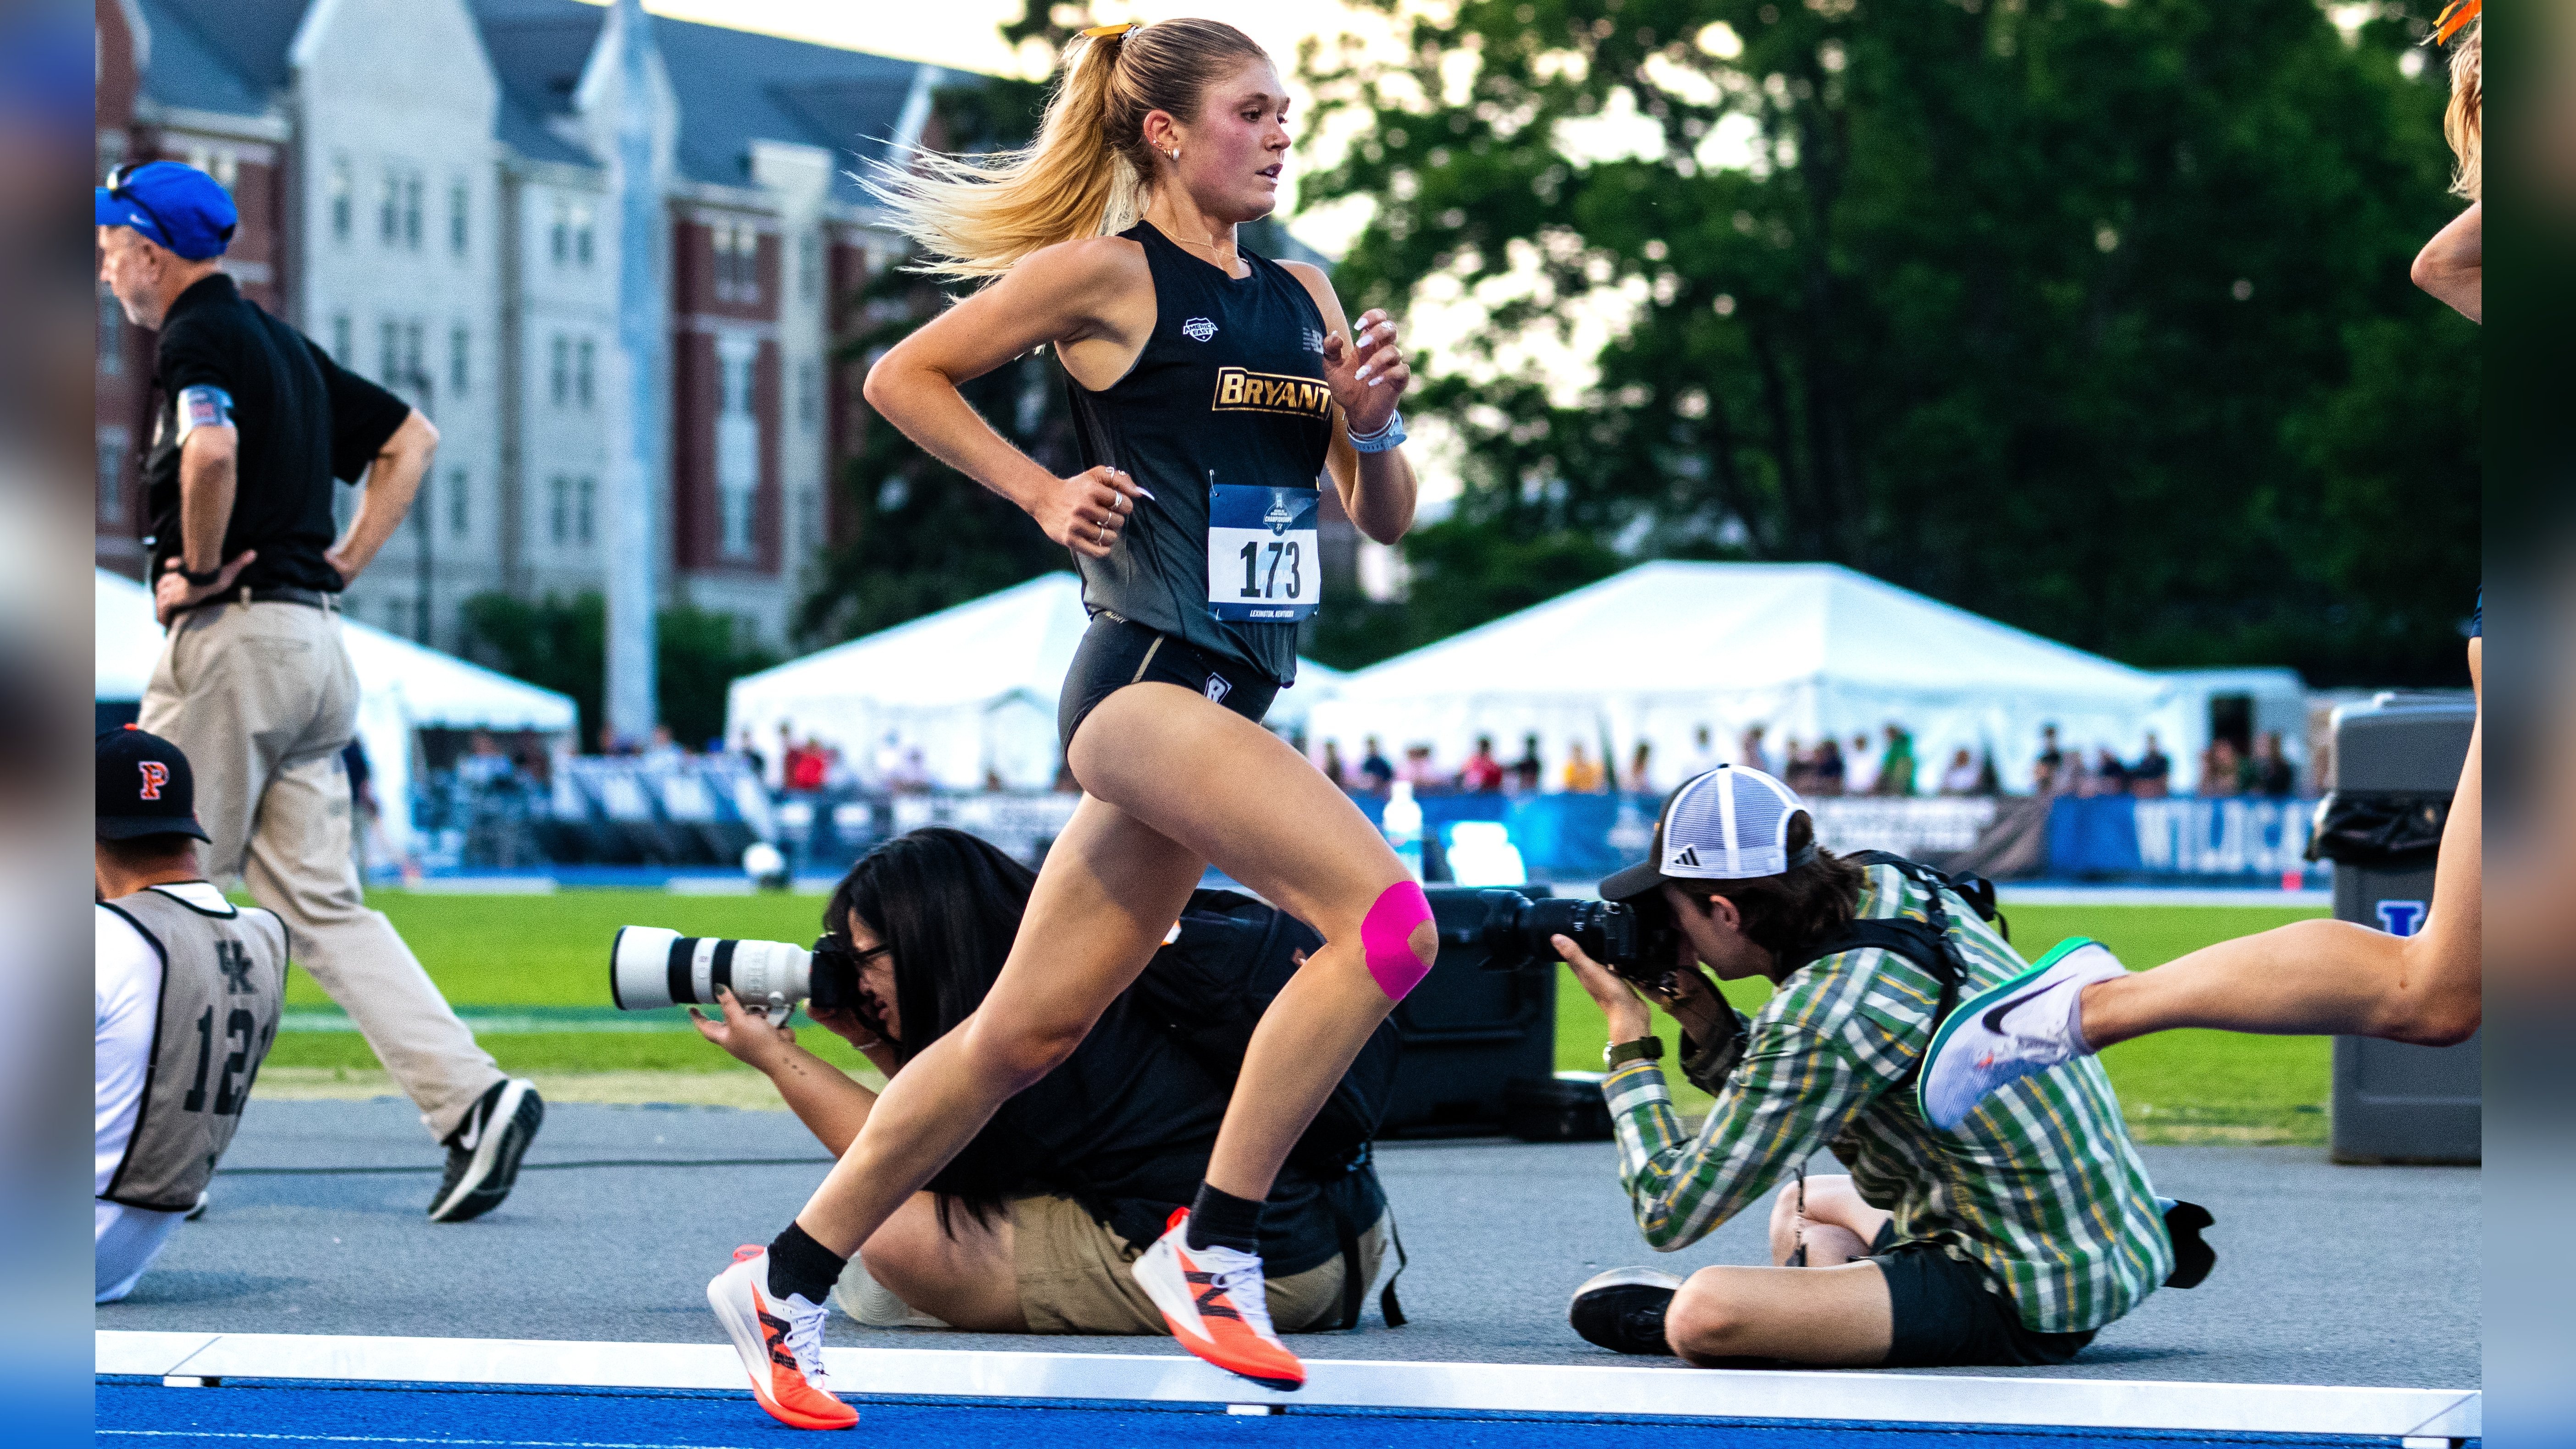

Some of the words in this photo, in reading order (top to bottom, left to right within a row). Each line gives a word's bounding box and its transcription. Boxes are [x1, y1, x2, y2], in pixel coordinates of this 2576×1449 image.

[1184, 323, 1216, 333] AMERICA
[1220, 373, 1331, 413] BRYANT
[1240, 541, 1301, 599] 173
[138, 761, 170, 800] P
